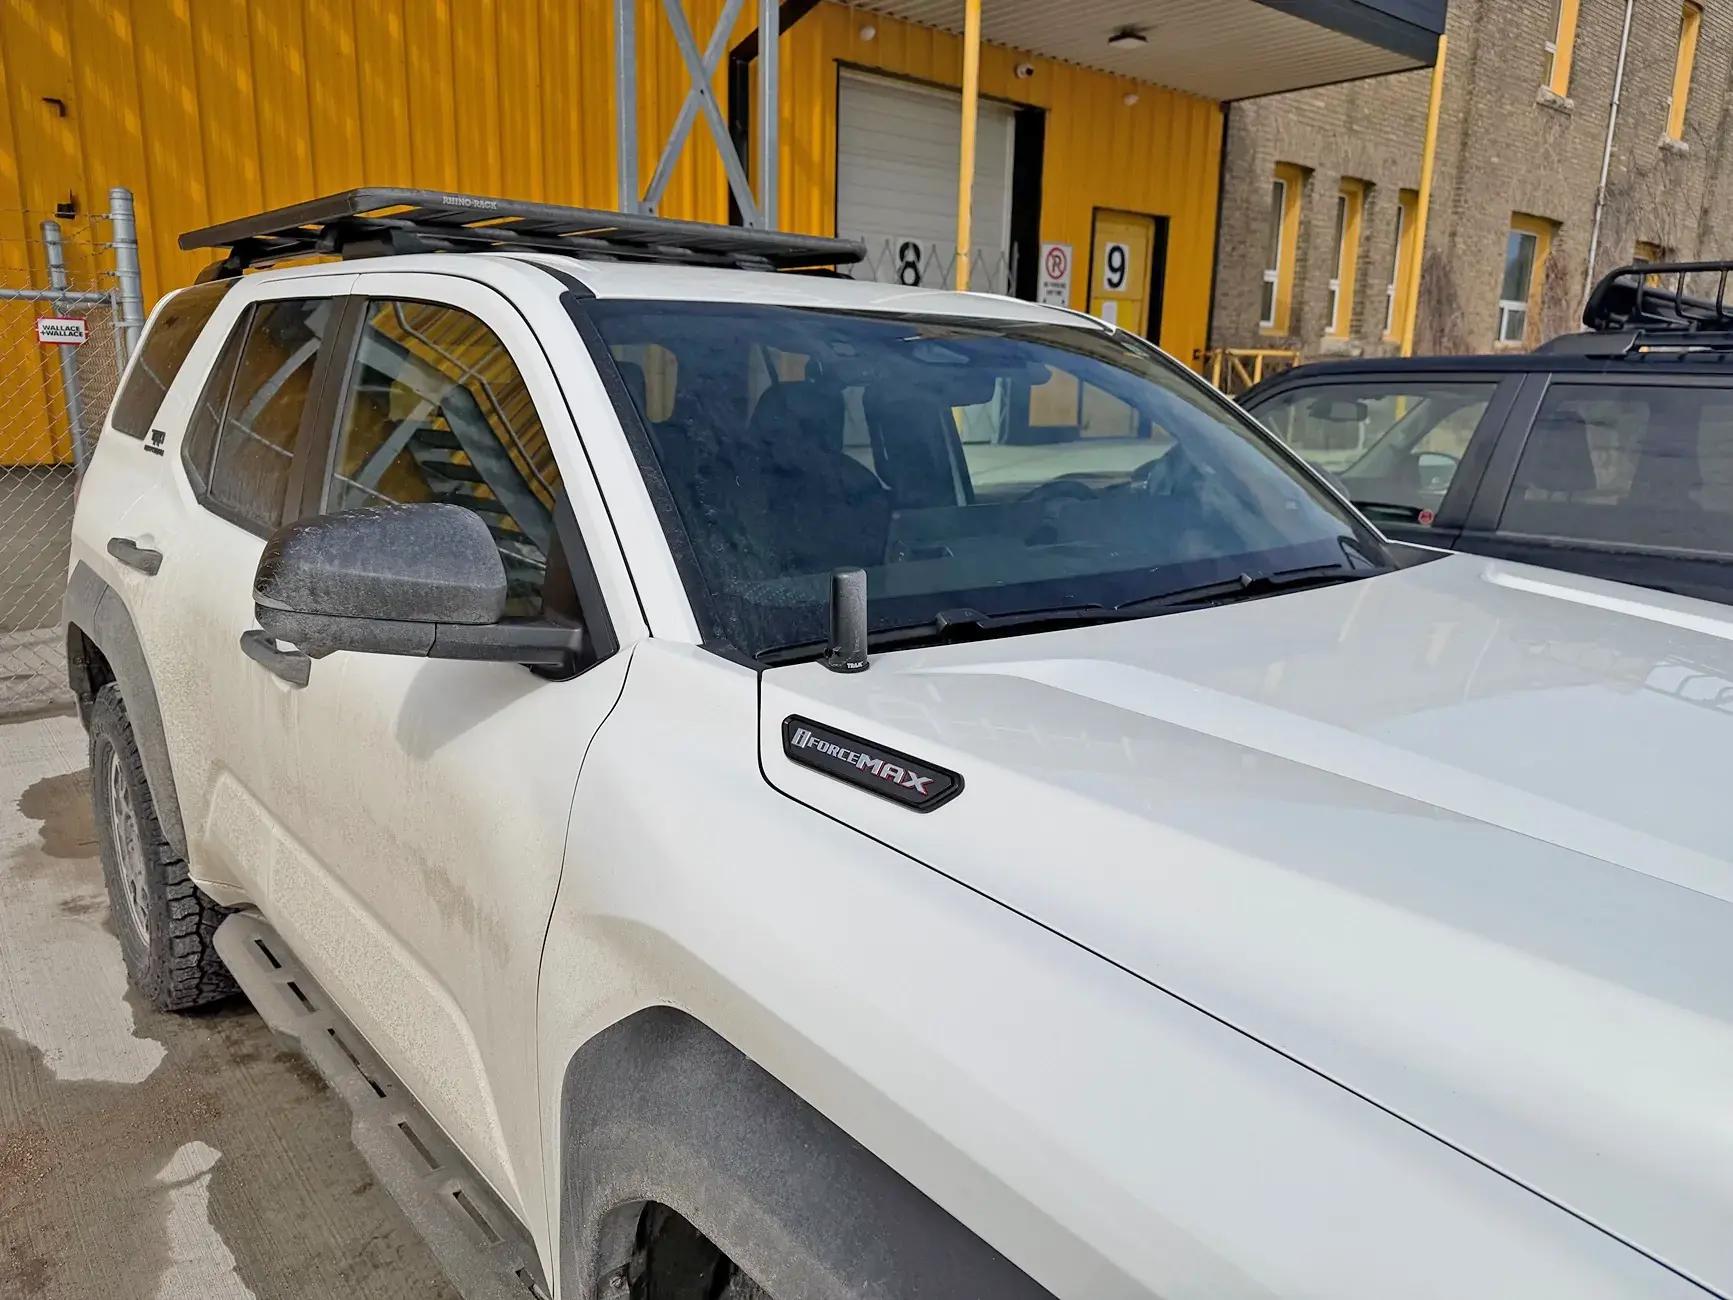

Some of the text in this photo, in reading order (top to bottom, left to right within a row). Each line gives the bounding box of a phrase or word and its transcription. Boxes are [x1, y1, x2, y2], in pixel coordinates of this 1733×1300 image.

[442, 196, 498, 210] RHINO-RACK
[900, 241, 921, 287] 8
[1107, 245, 1126, 289] 9
[42, 324, 81, 332] WALLACE
